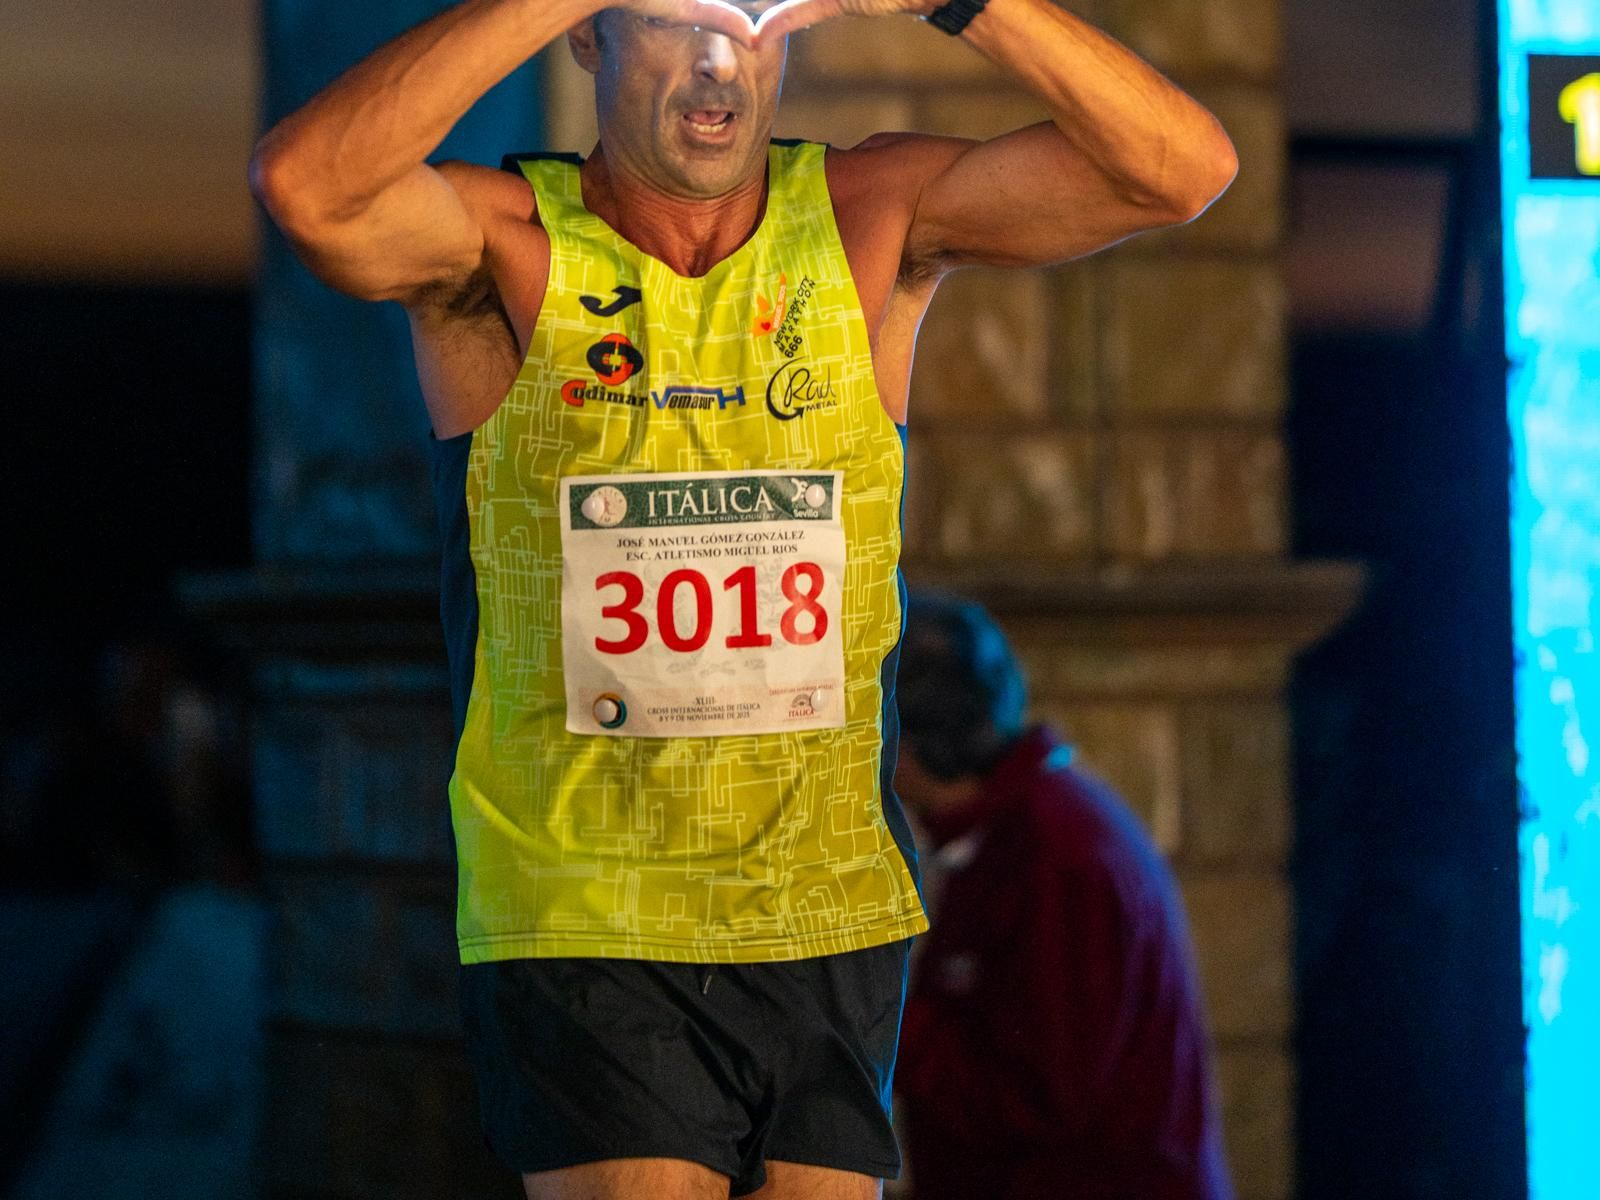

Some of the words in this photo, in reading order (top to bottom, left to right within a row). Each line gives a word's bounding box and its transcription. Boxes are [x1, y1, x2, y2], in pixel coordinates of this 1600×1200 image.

[784, 297, 800, 324] YORK
[797, 274, 809, 297] CITY
[779, 280, 816, 353] MARATHON
[784, 335, 803, 358] 666
[806, 400, 838, 412] METAL
[647, 482, 776, 518] ITÁLICA
[793, 508, 819, 519] Sevilla
[616, 536, 645, 549] JOSÉ
[649, 534, 698, 548] MANUEL
[700, 532, 743, 545] GÓMEZ
[745, 529, 806, 543] GONZÁLEZ
[626, 550, 650, 561] ESC.
[654, 547, 721, 560] ATLETISMO
[724, 545, 769, 557] MIGUEL
[595, 561, 828, 655] 3018
[686, 712, 725, 721] NOVIEMBRE
